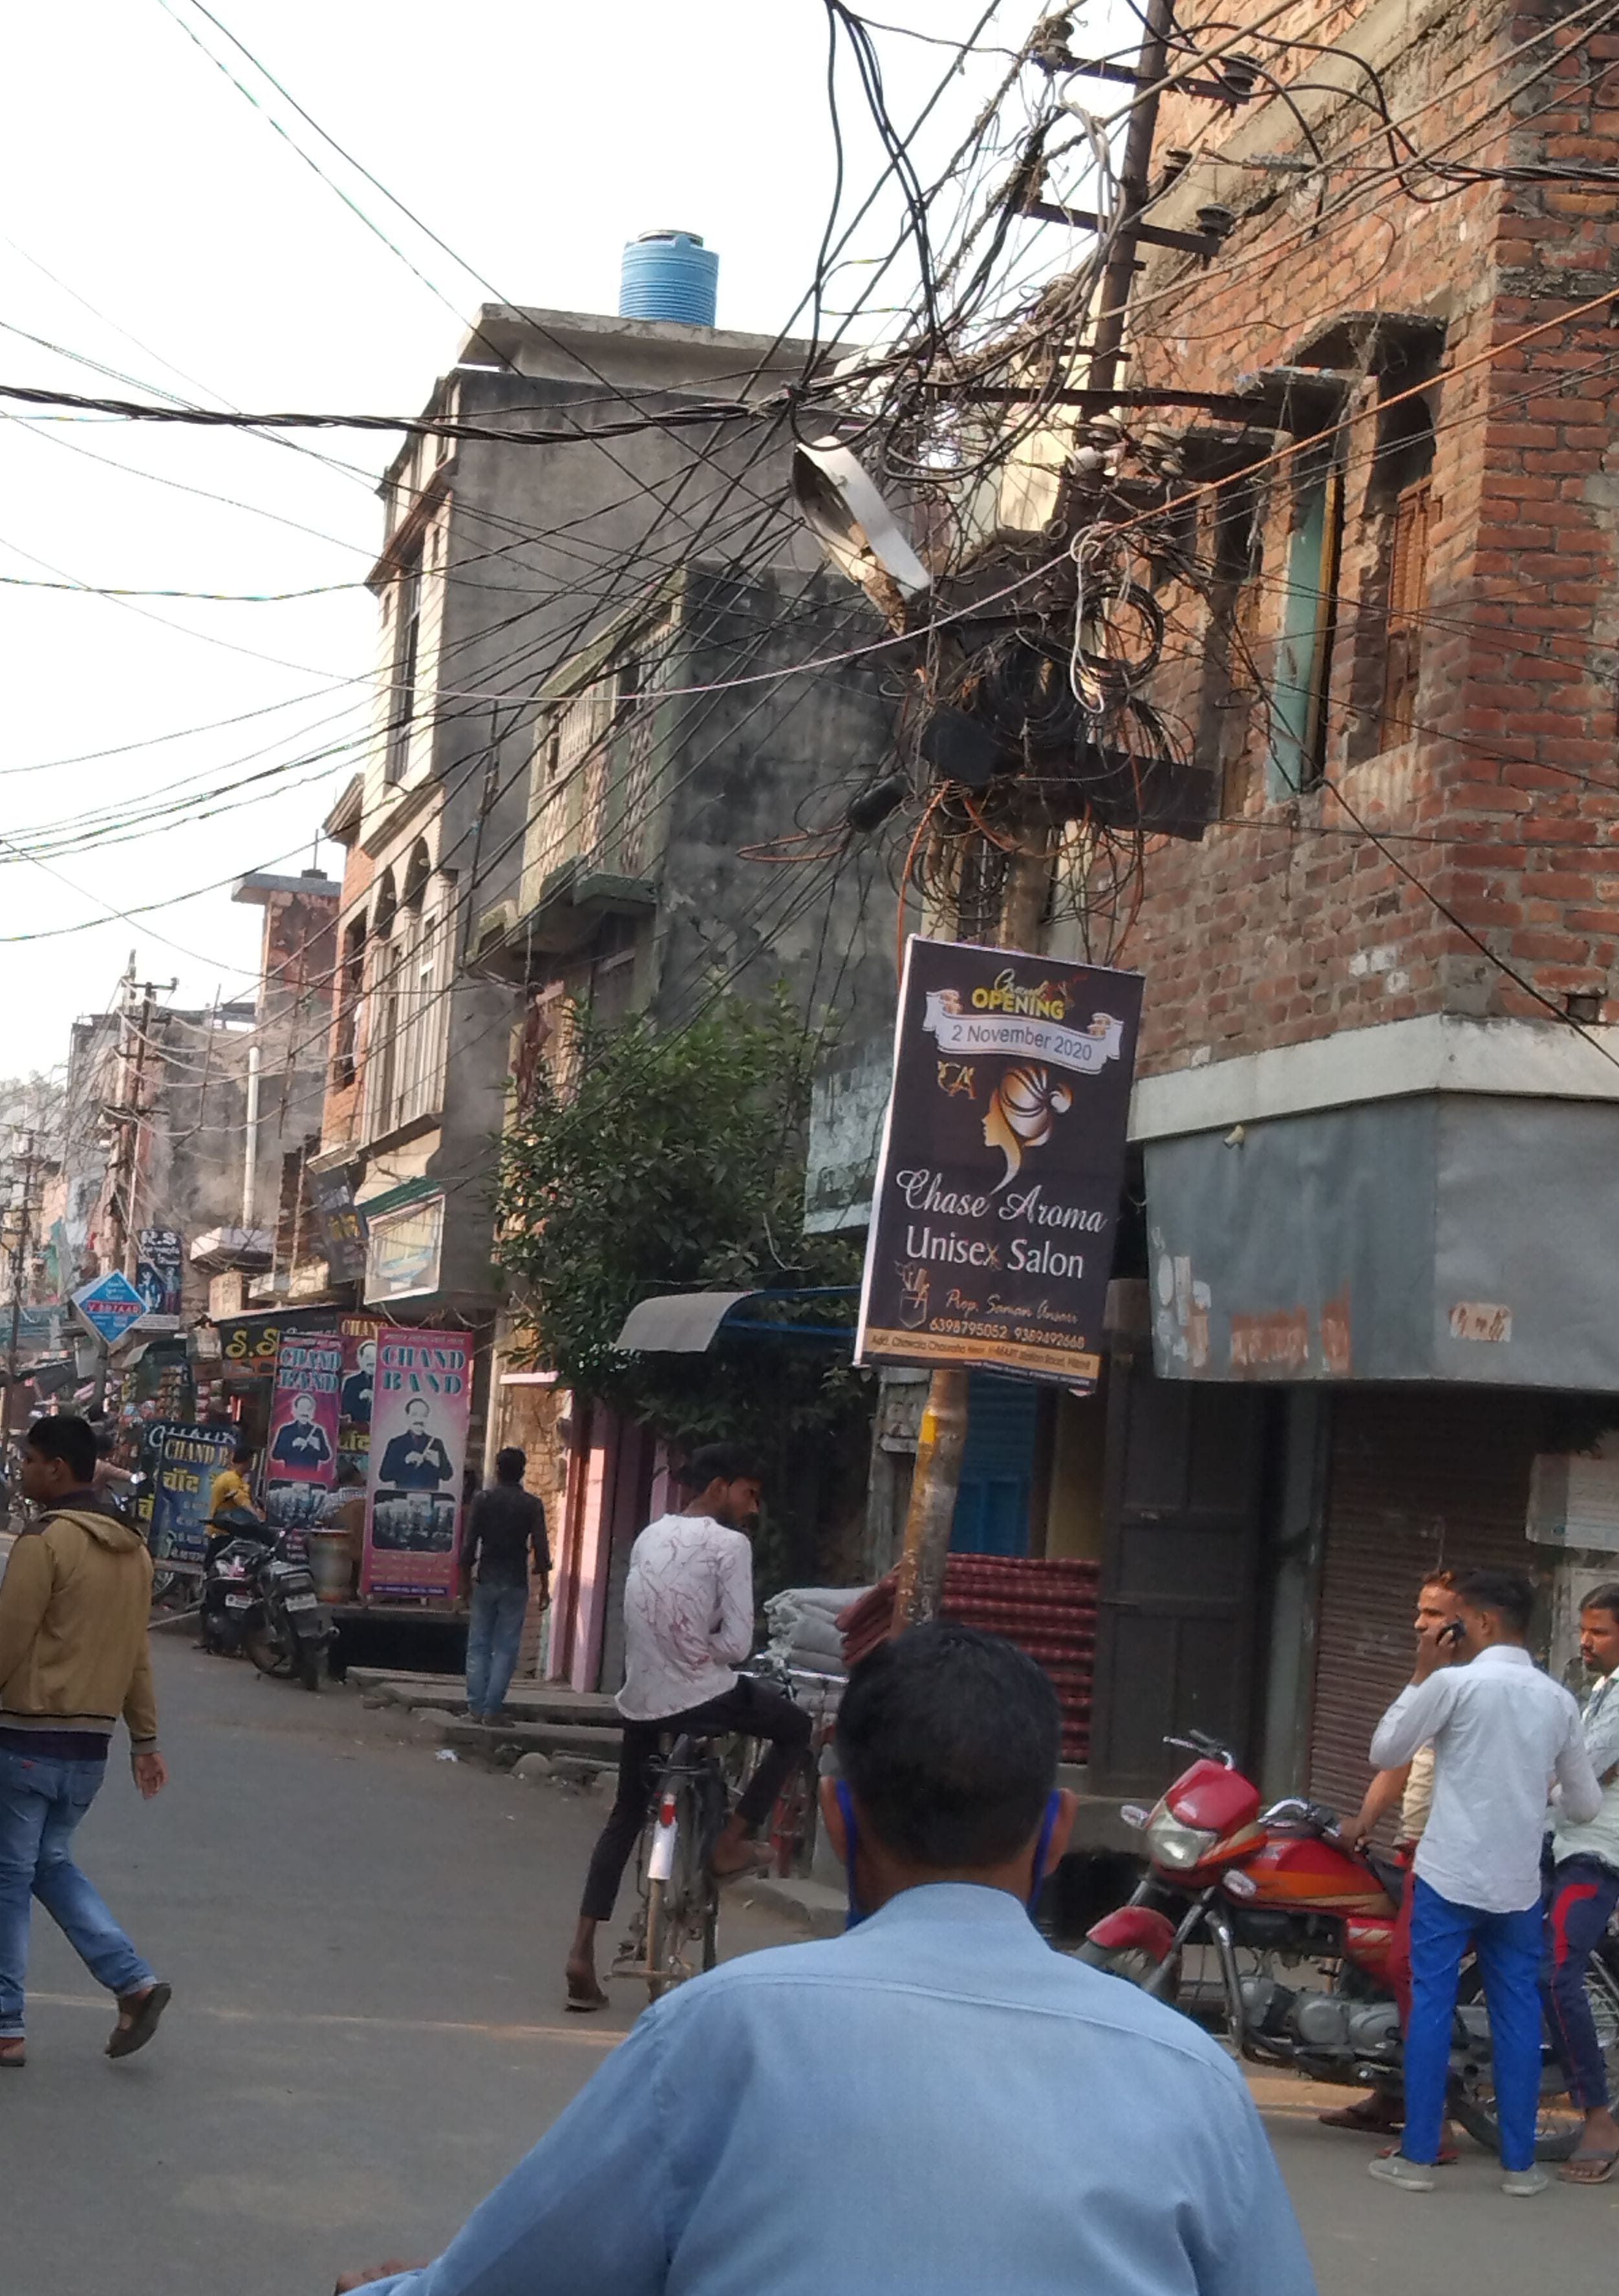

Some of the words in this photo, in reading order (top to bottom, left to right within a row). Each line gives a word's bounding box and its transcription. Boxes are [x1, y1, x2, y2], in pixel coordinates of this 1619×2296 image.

[972, 988, 1066, 1019] OPENING
[951, 1025, 961, 1042] 2
[967, 1025, 1051, 1052] November
[1054, 1036, 1092, 1061] 2020
[896, 1169, 991, 1218] Chase
[906, 1226, 1002, 1271] Unisex
[1007, 1239, 1084, 1279] Salon
[280, 1346, 341, 1371] CHAND
[383, 1345, 466, 1370] CHAND
[279, 1368, 339, 1393] BAND
[383, 1370, 462, 1395] BAND
[166, 1438, 215, 1464] CHAND
